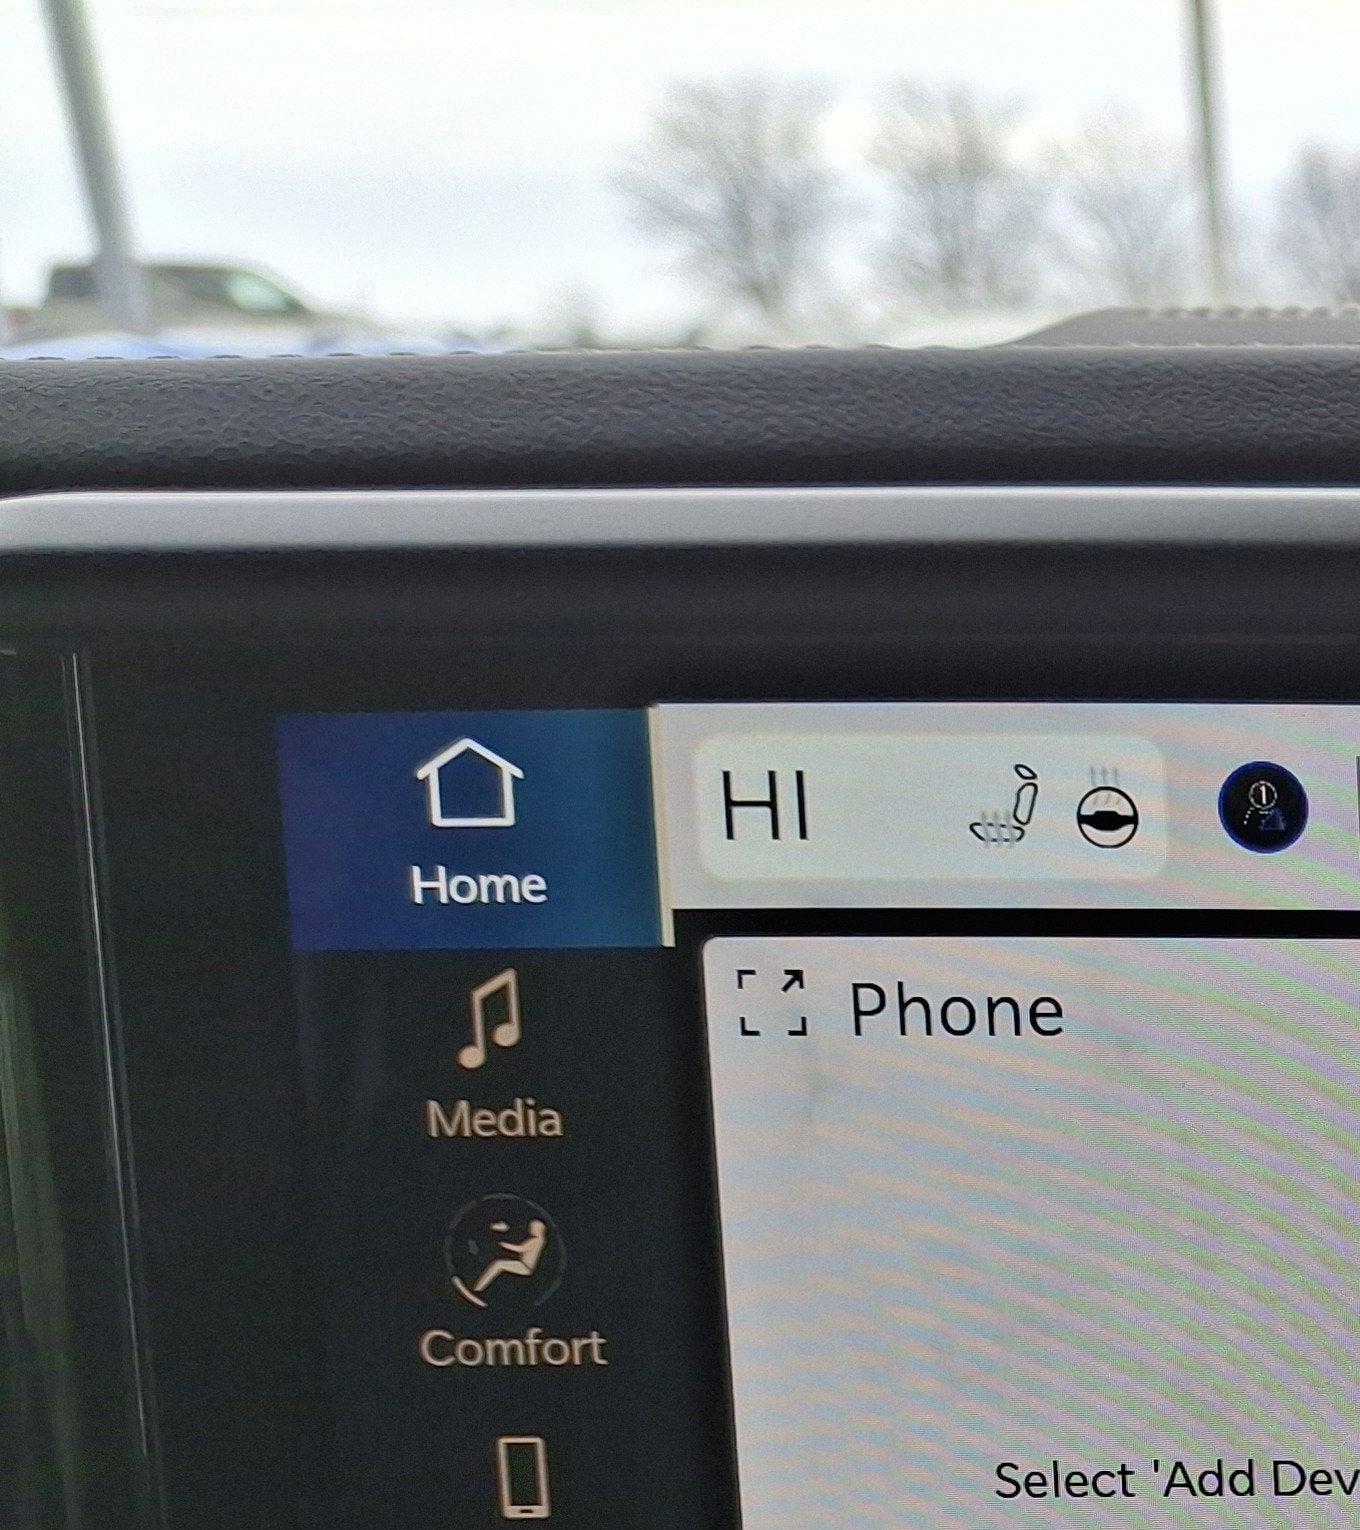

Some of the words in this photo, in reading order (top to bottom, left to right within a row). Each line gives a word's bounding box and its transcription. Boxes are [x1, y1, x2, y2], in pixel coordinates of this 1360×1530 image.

[721, 769, 809, 842] HI
[410, 864, 549, 906] Home
[850, 979, 1064, 1038] Phone
[425, 1096, 564, 1139] Media
[419, 1326, 609, 1368] Comfort
[994, 1457, 1137, 1500] Select
[1151, 1456, 1258, 1499] 'Add
